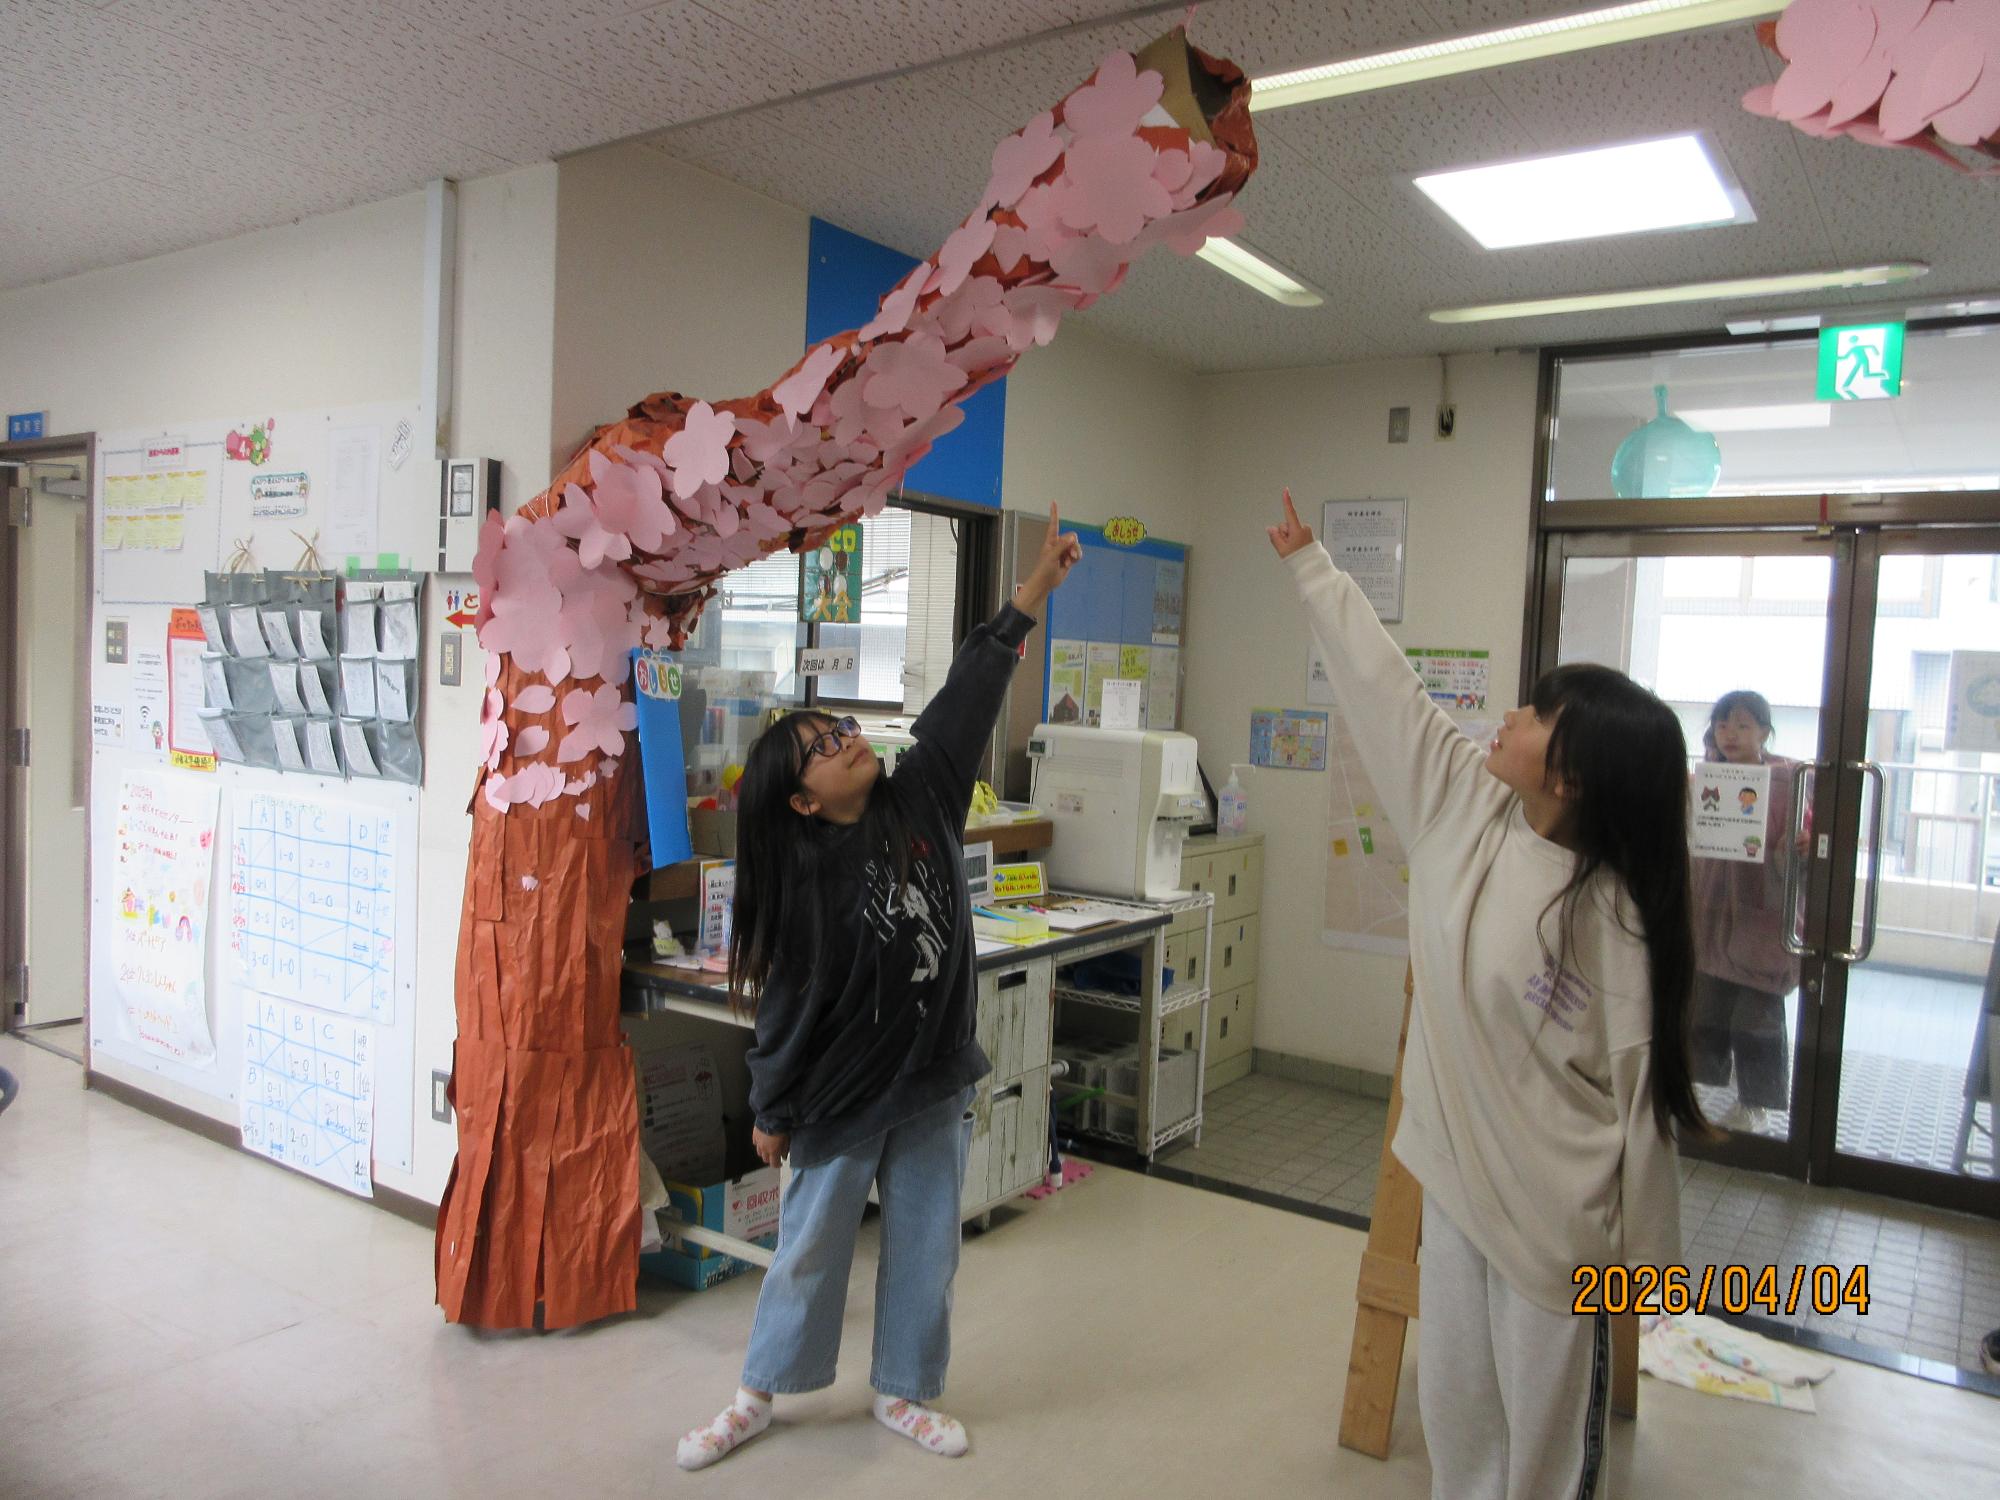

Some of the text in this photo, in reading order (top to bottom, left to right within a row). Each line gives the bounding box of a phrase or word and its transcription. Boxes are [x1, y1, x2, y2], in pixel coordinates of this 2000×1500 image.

[813, 590, 852, 622] 大会
[802, 657, 853, 671] 次回は 月 日
[639, 662, 680, 692] おしらせ
[267, 1005, 275, 1024] A
[295, 1016, 303, 1031] B
[323, 1024, 335, 1040] C
[247, 1033, 254, 1048] A
[248, 1067, 257, 1085] B
